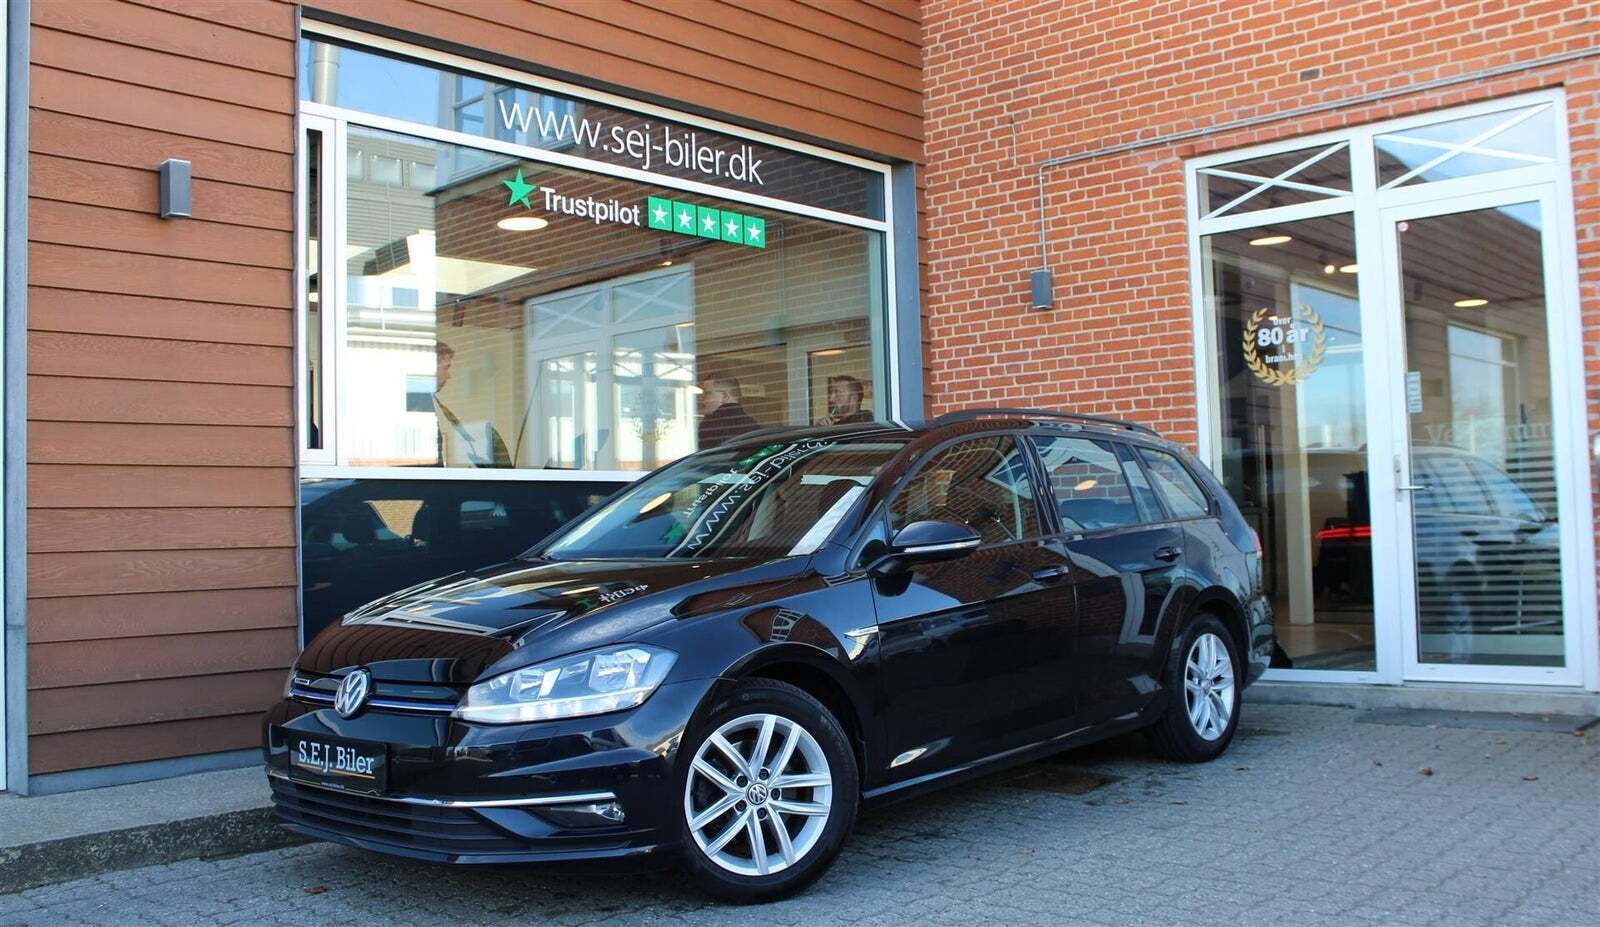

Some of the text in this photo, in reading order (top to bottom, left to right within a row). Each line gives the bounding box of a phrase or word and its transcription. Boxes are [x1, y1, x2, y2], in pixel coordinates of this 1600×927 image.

[498, 98, 764, 185] www.sej-biler.dk
[539, 186, 641, 226] Trustpilot
[1257, 327, 1284, 347] 80
[298, 740, 375, 774] S.E.J. Biler
